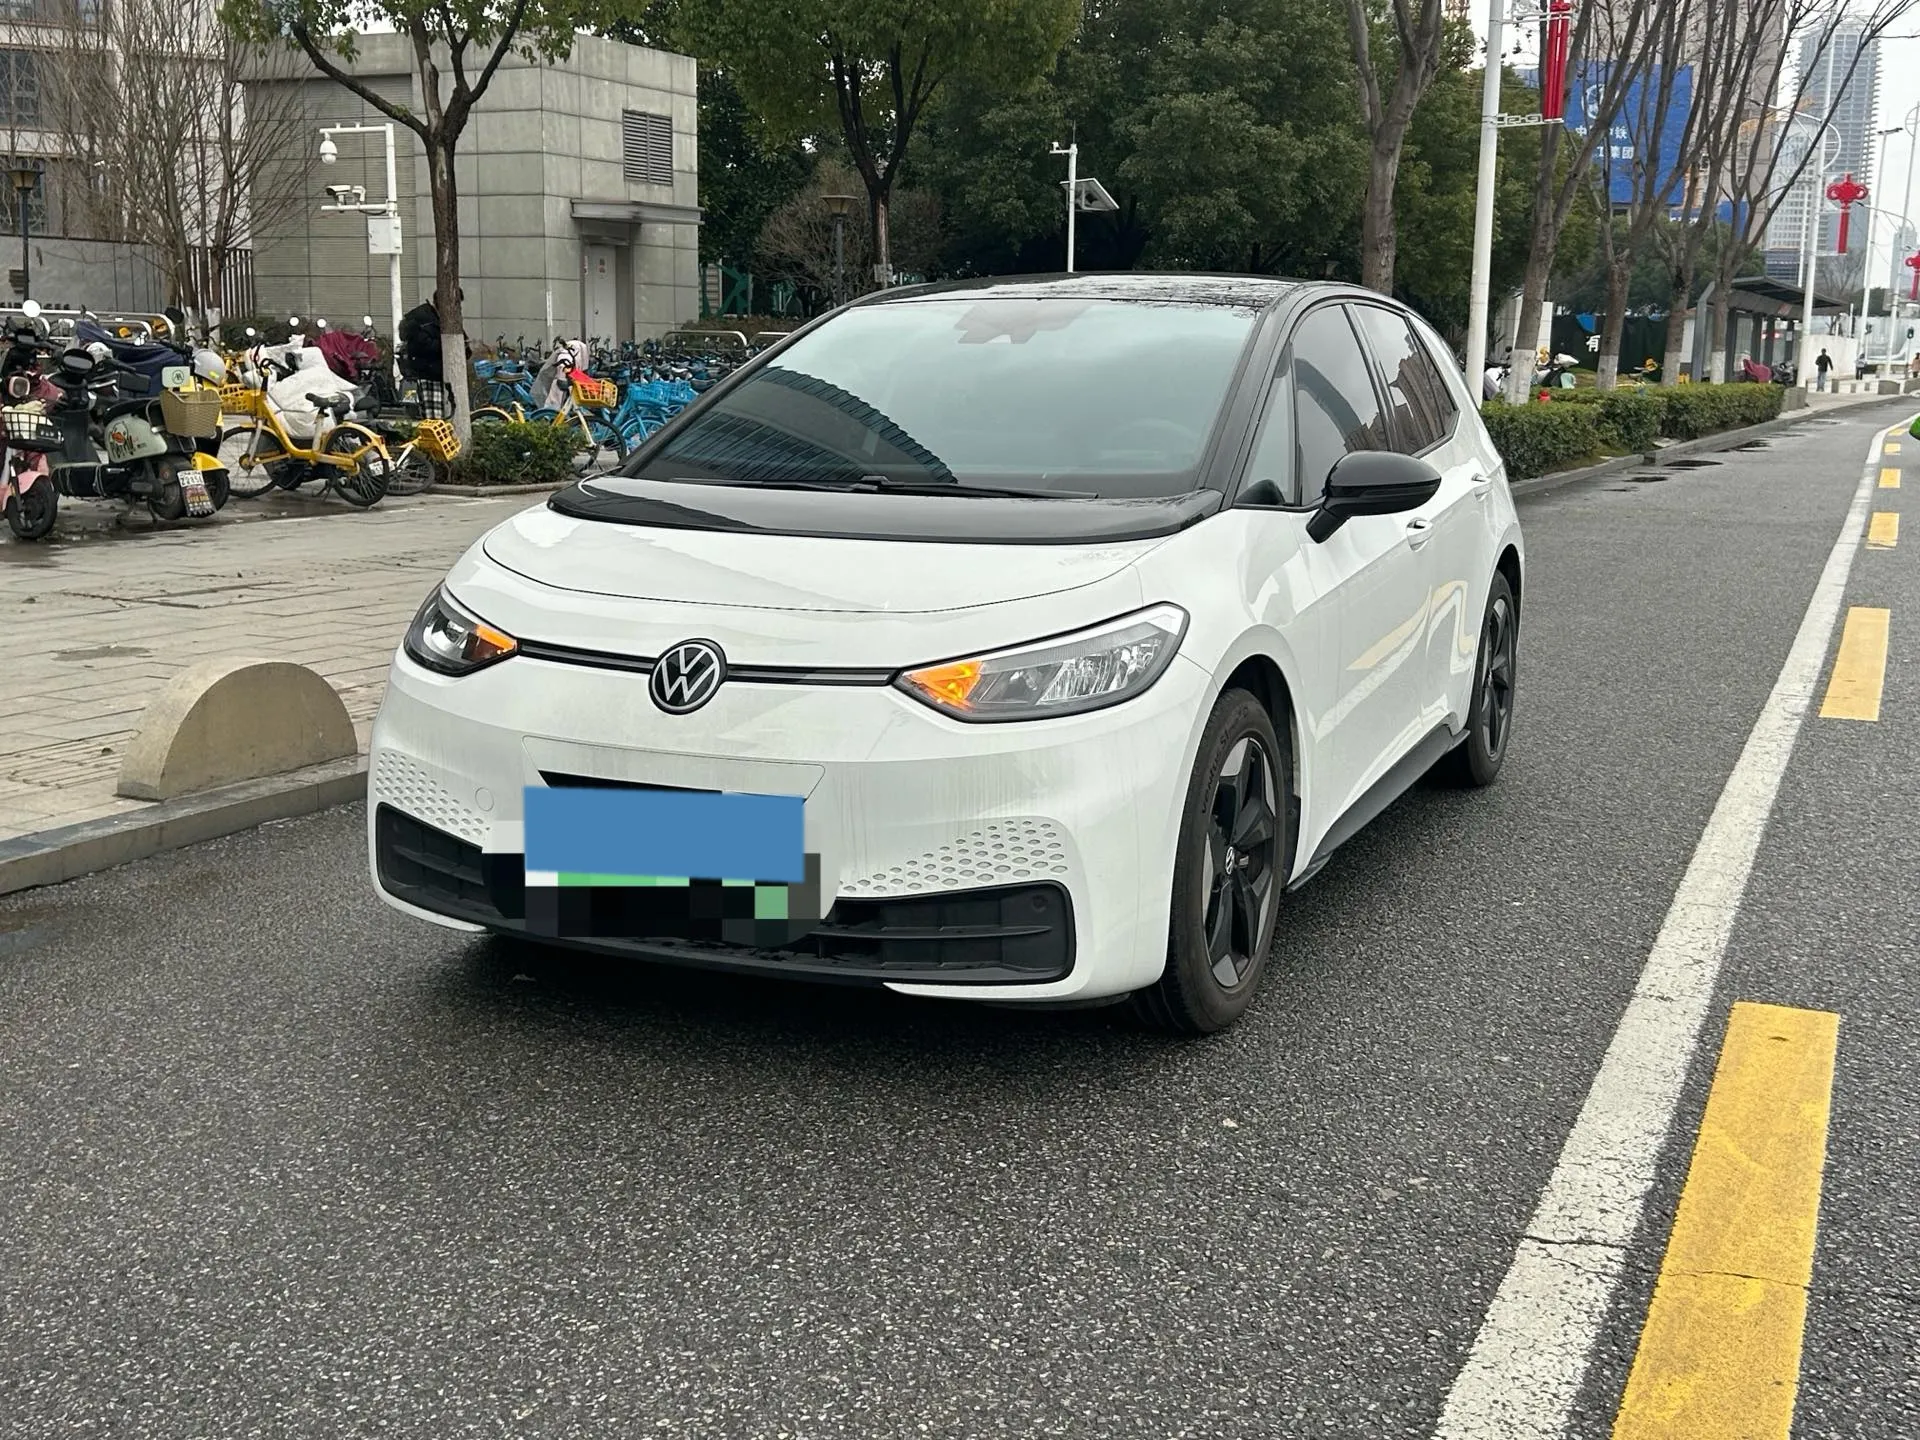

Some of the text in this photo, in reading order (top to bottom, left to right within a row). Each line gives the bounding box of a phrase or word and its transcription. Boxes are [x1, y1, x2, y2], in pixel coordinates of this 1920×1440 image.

[1575, 125, 1627, 139] 中铁
[1593, 145, 1634, 160] 工集团
